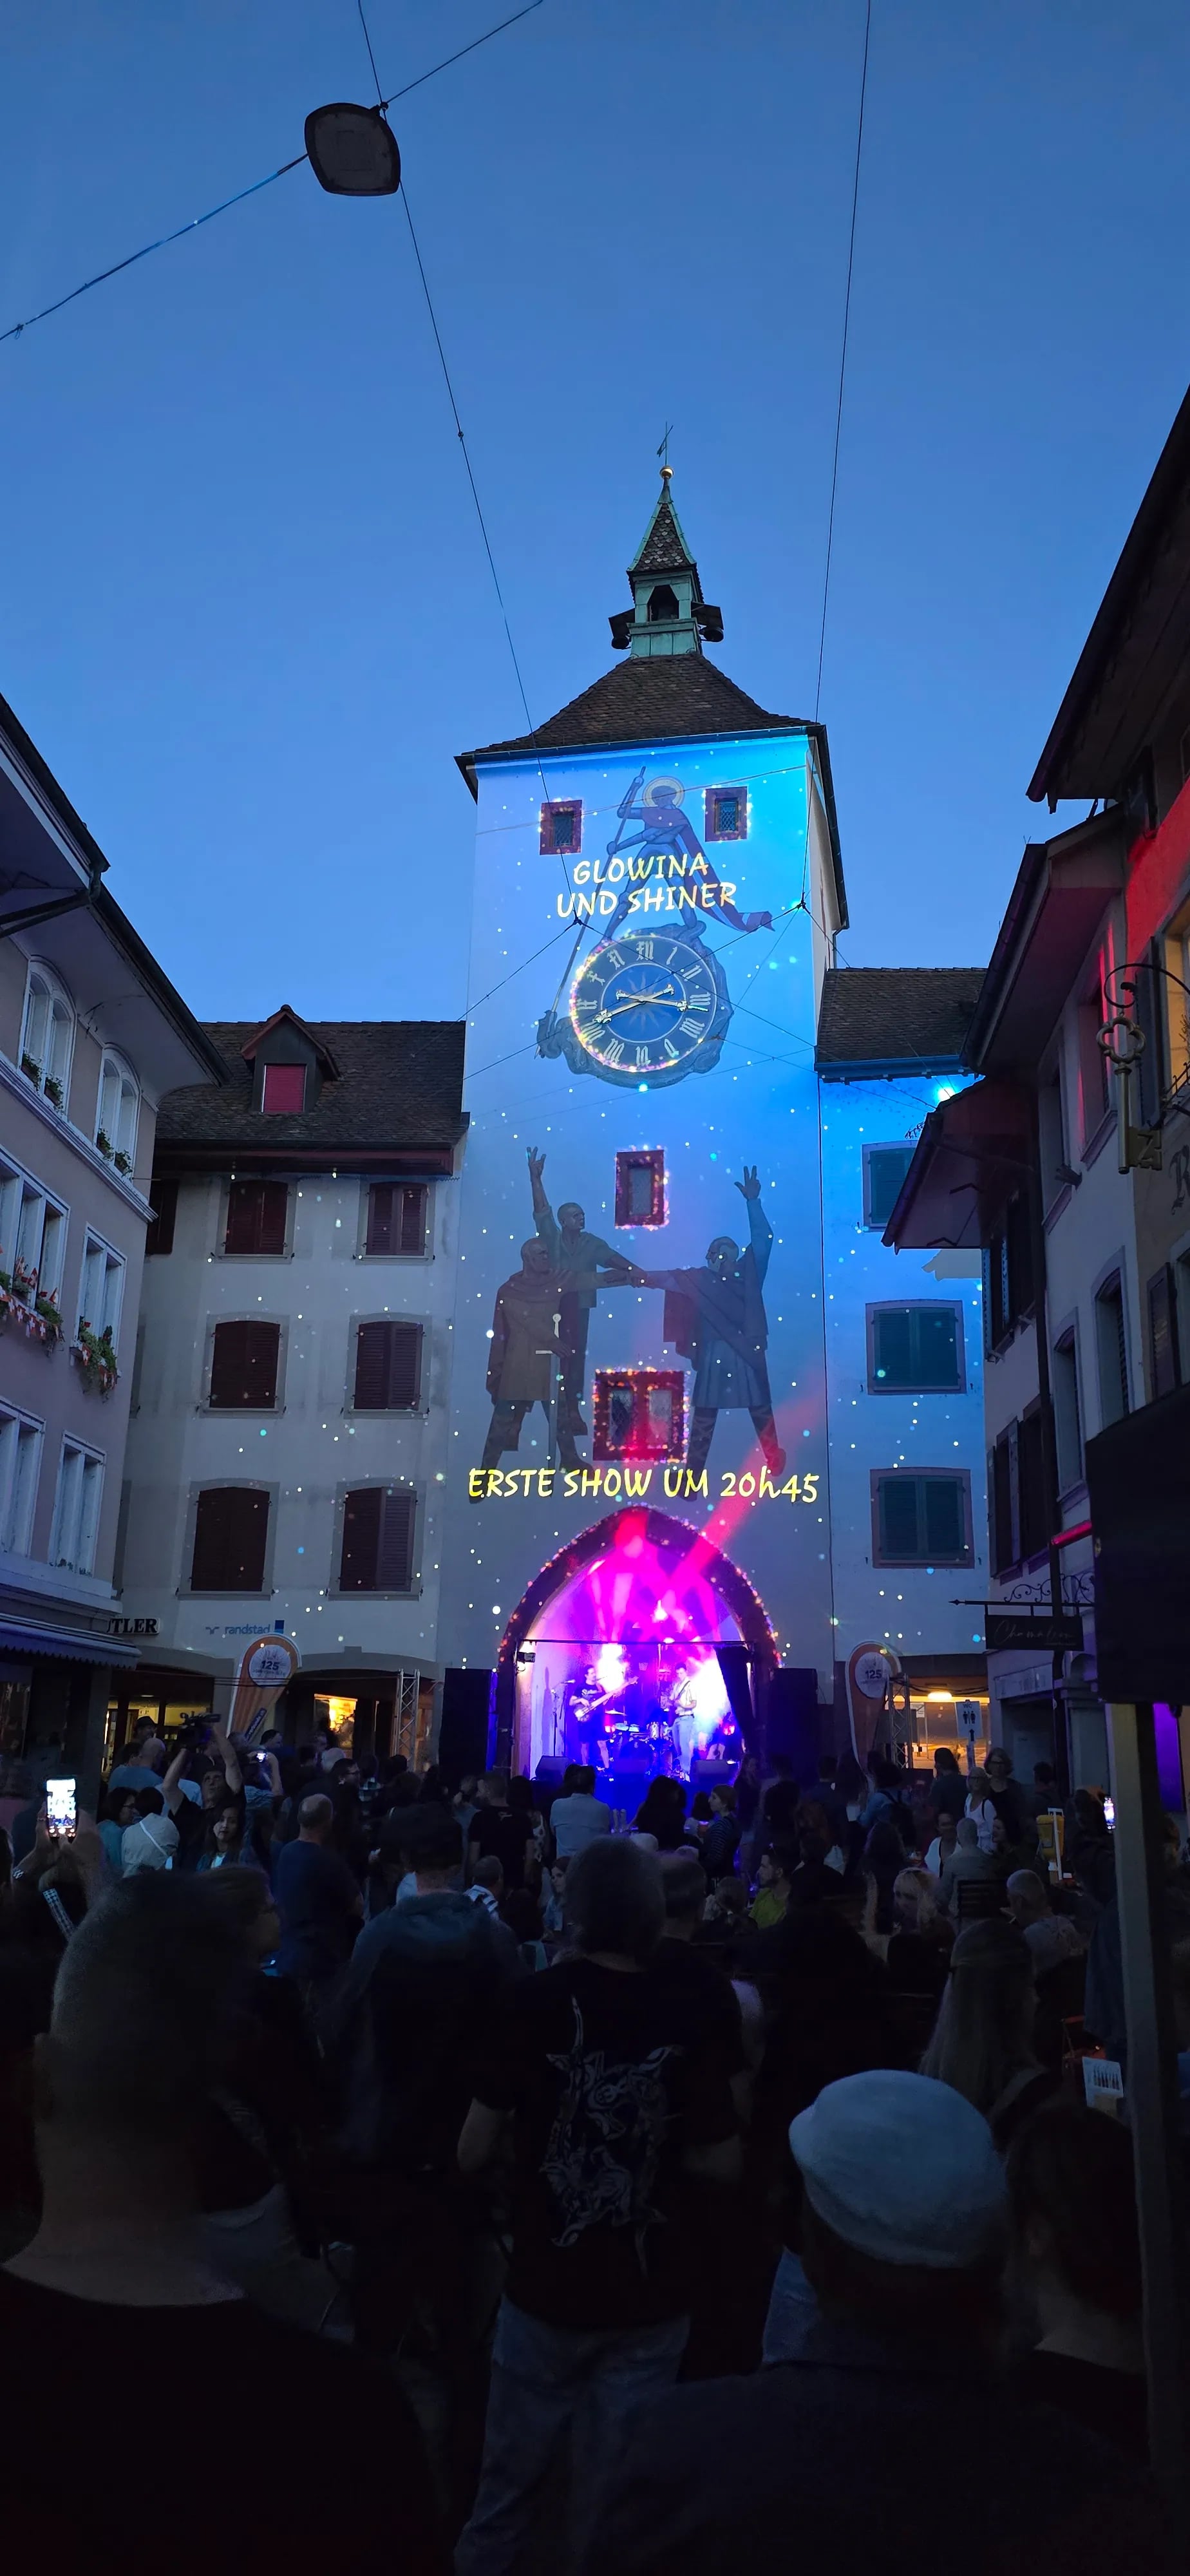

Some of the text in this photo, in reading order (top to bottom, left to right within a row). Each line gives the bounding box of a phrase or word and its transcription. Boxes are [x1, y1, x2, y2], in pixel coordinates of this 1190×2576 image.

[573, 853, 708, 884] GLOWINA
[557, 882, 737, 918] UND SHINER
[468, 1465, 819, 1502] ERSTE SHOW UM 20h45
[107, 1618, 156, 1633] TLER
[225, 1624, 270, 1634] randstad
[261, 1660, 280, 1670] 125
[865, 1669, 882, 1680] 125
